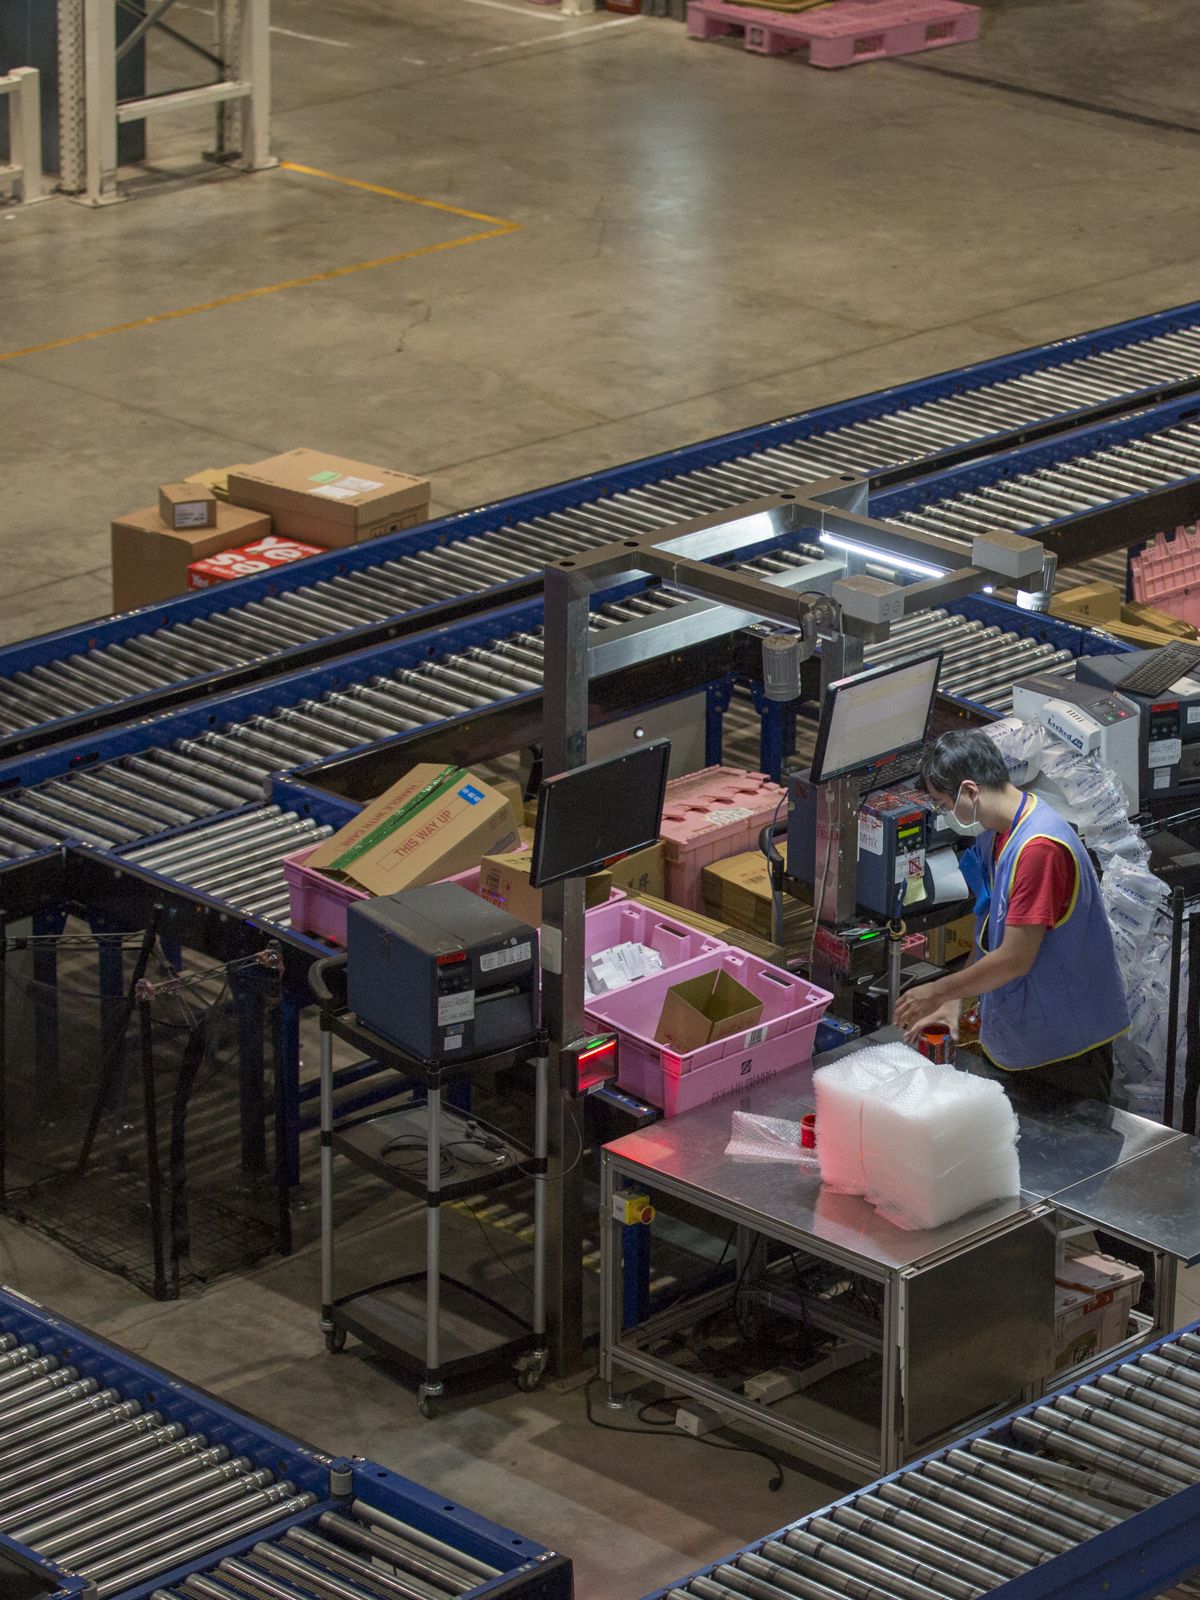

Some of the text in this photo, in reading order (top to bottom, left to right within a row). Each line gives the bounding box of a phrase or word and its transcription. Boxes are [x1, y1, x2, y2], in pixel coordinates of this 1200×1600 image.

[393, 809, 453, 858] THIS WAY UP
